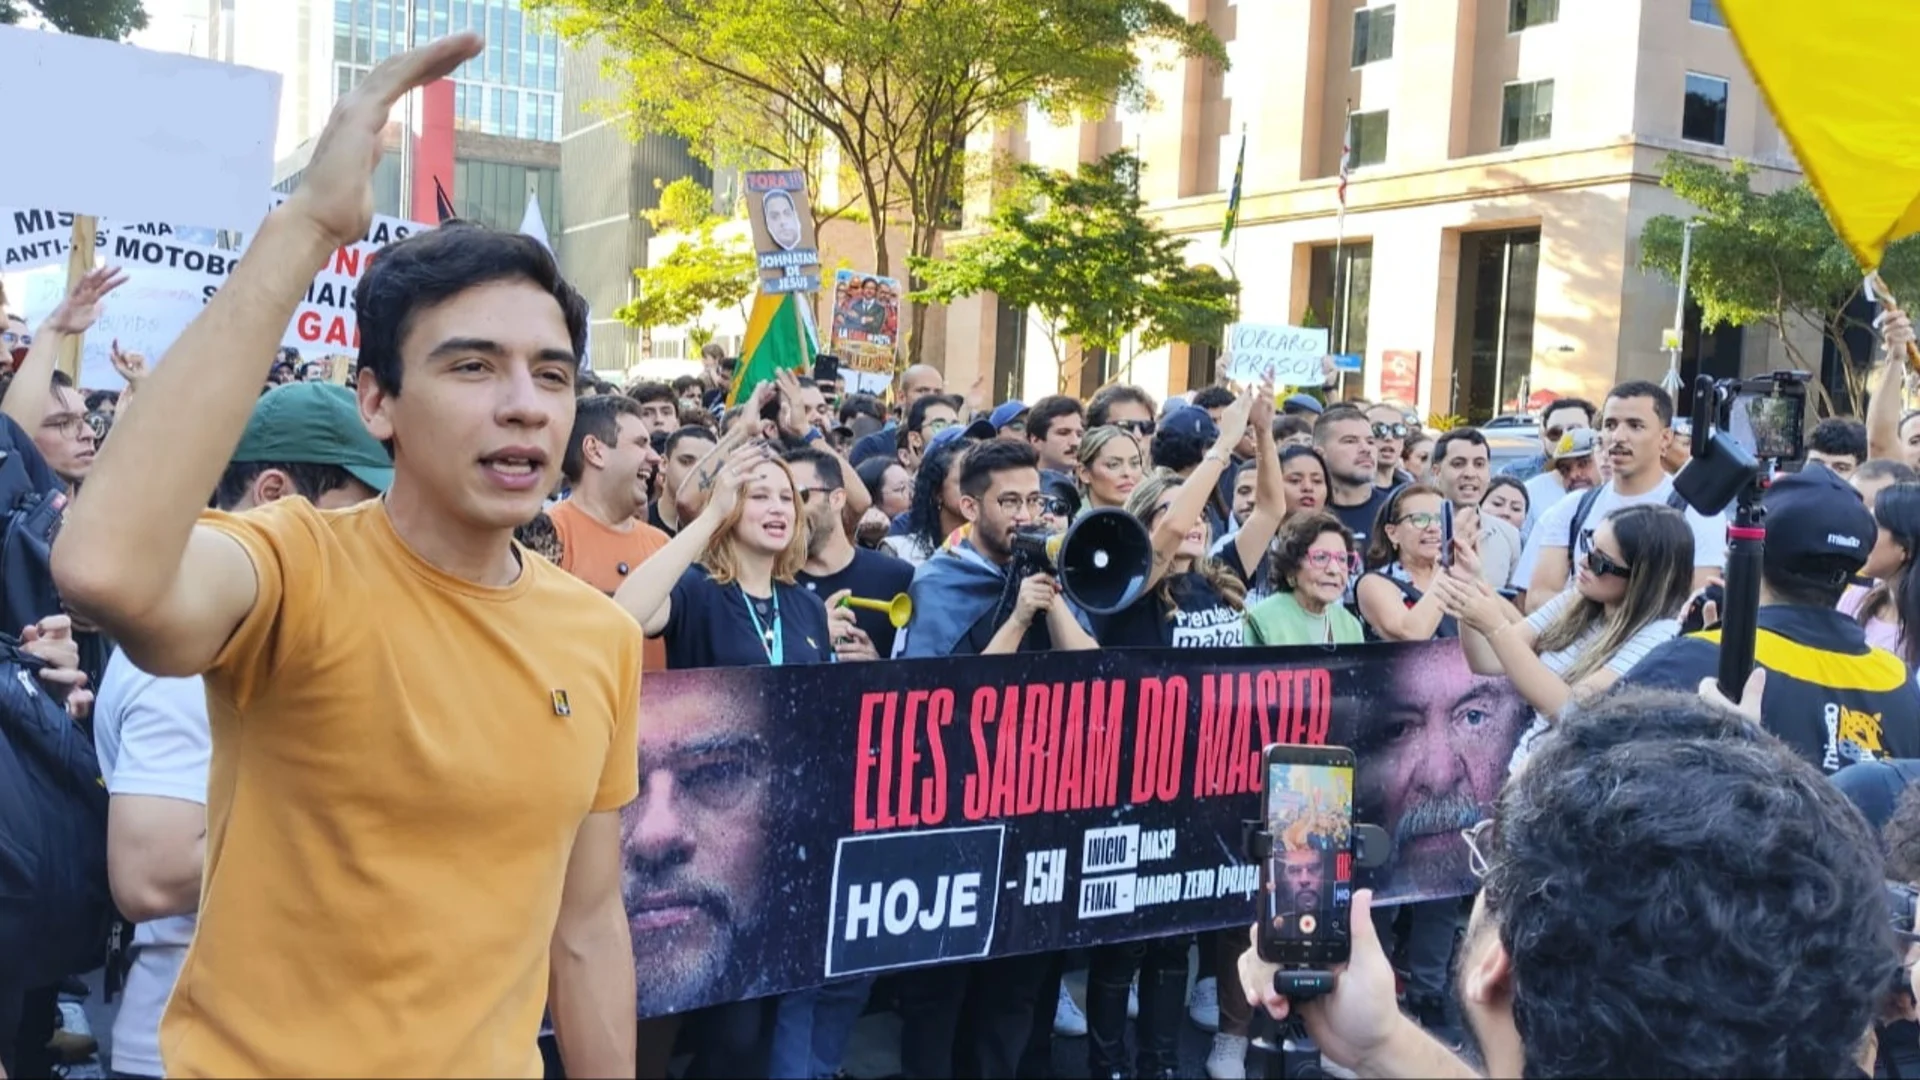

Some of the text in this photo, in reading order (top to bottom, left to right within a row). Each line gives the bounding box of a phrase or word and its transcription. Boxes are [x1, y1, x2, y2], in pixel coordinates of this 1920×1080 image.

[853, 668, 1331, 831] ELES SABIAM DO MASTER
[1087, 829, 1127, 868] INÍCIO
[1139, 828, 1176, 861] MASP
[845, 872, 982, 941] HOJE
[1023, 848, 1067, 906] 15H
[1083, 879, 1118, 913] FINAL
[1135, 872, 1181, 907] MARCO
[1183, 868, 1215, 900] ZERO
